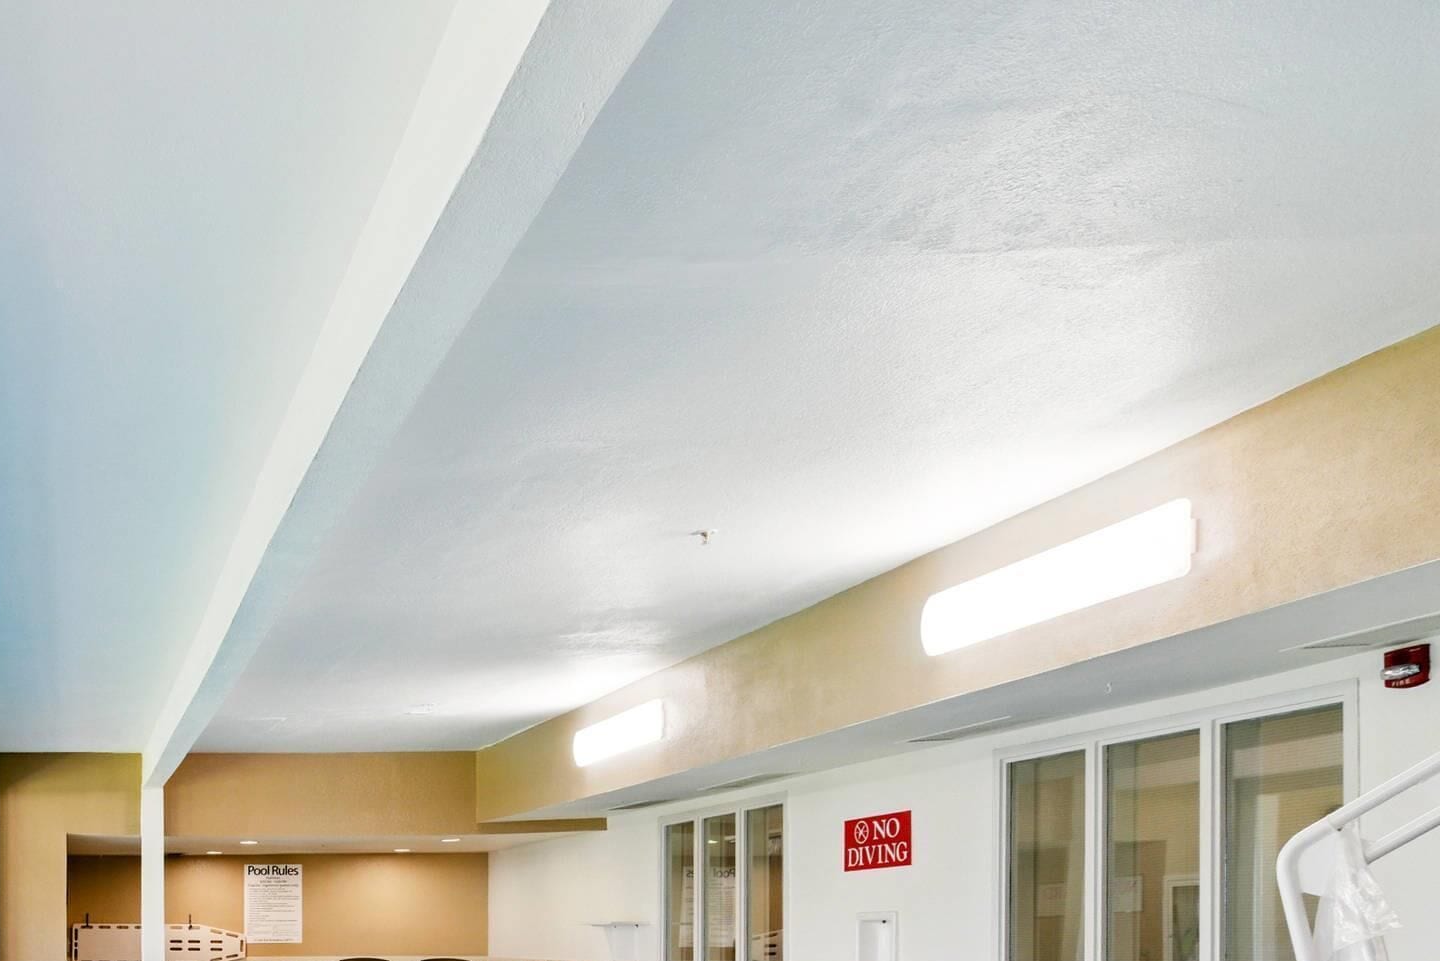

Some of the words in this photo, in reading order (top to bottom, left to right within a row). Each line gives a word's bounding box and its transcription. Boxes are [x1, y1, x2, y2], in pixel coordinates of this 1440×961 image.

[872, 817, 901, 840] NO
[847, 840, 909, 868] DIVING
[247, 865, 271, 876] Pool
[271, 865, 299, 876] Rules
